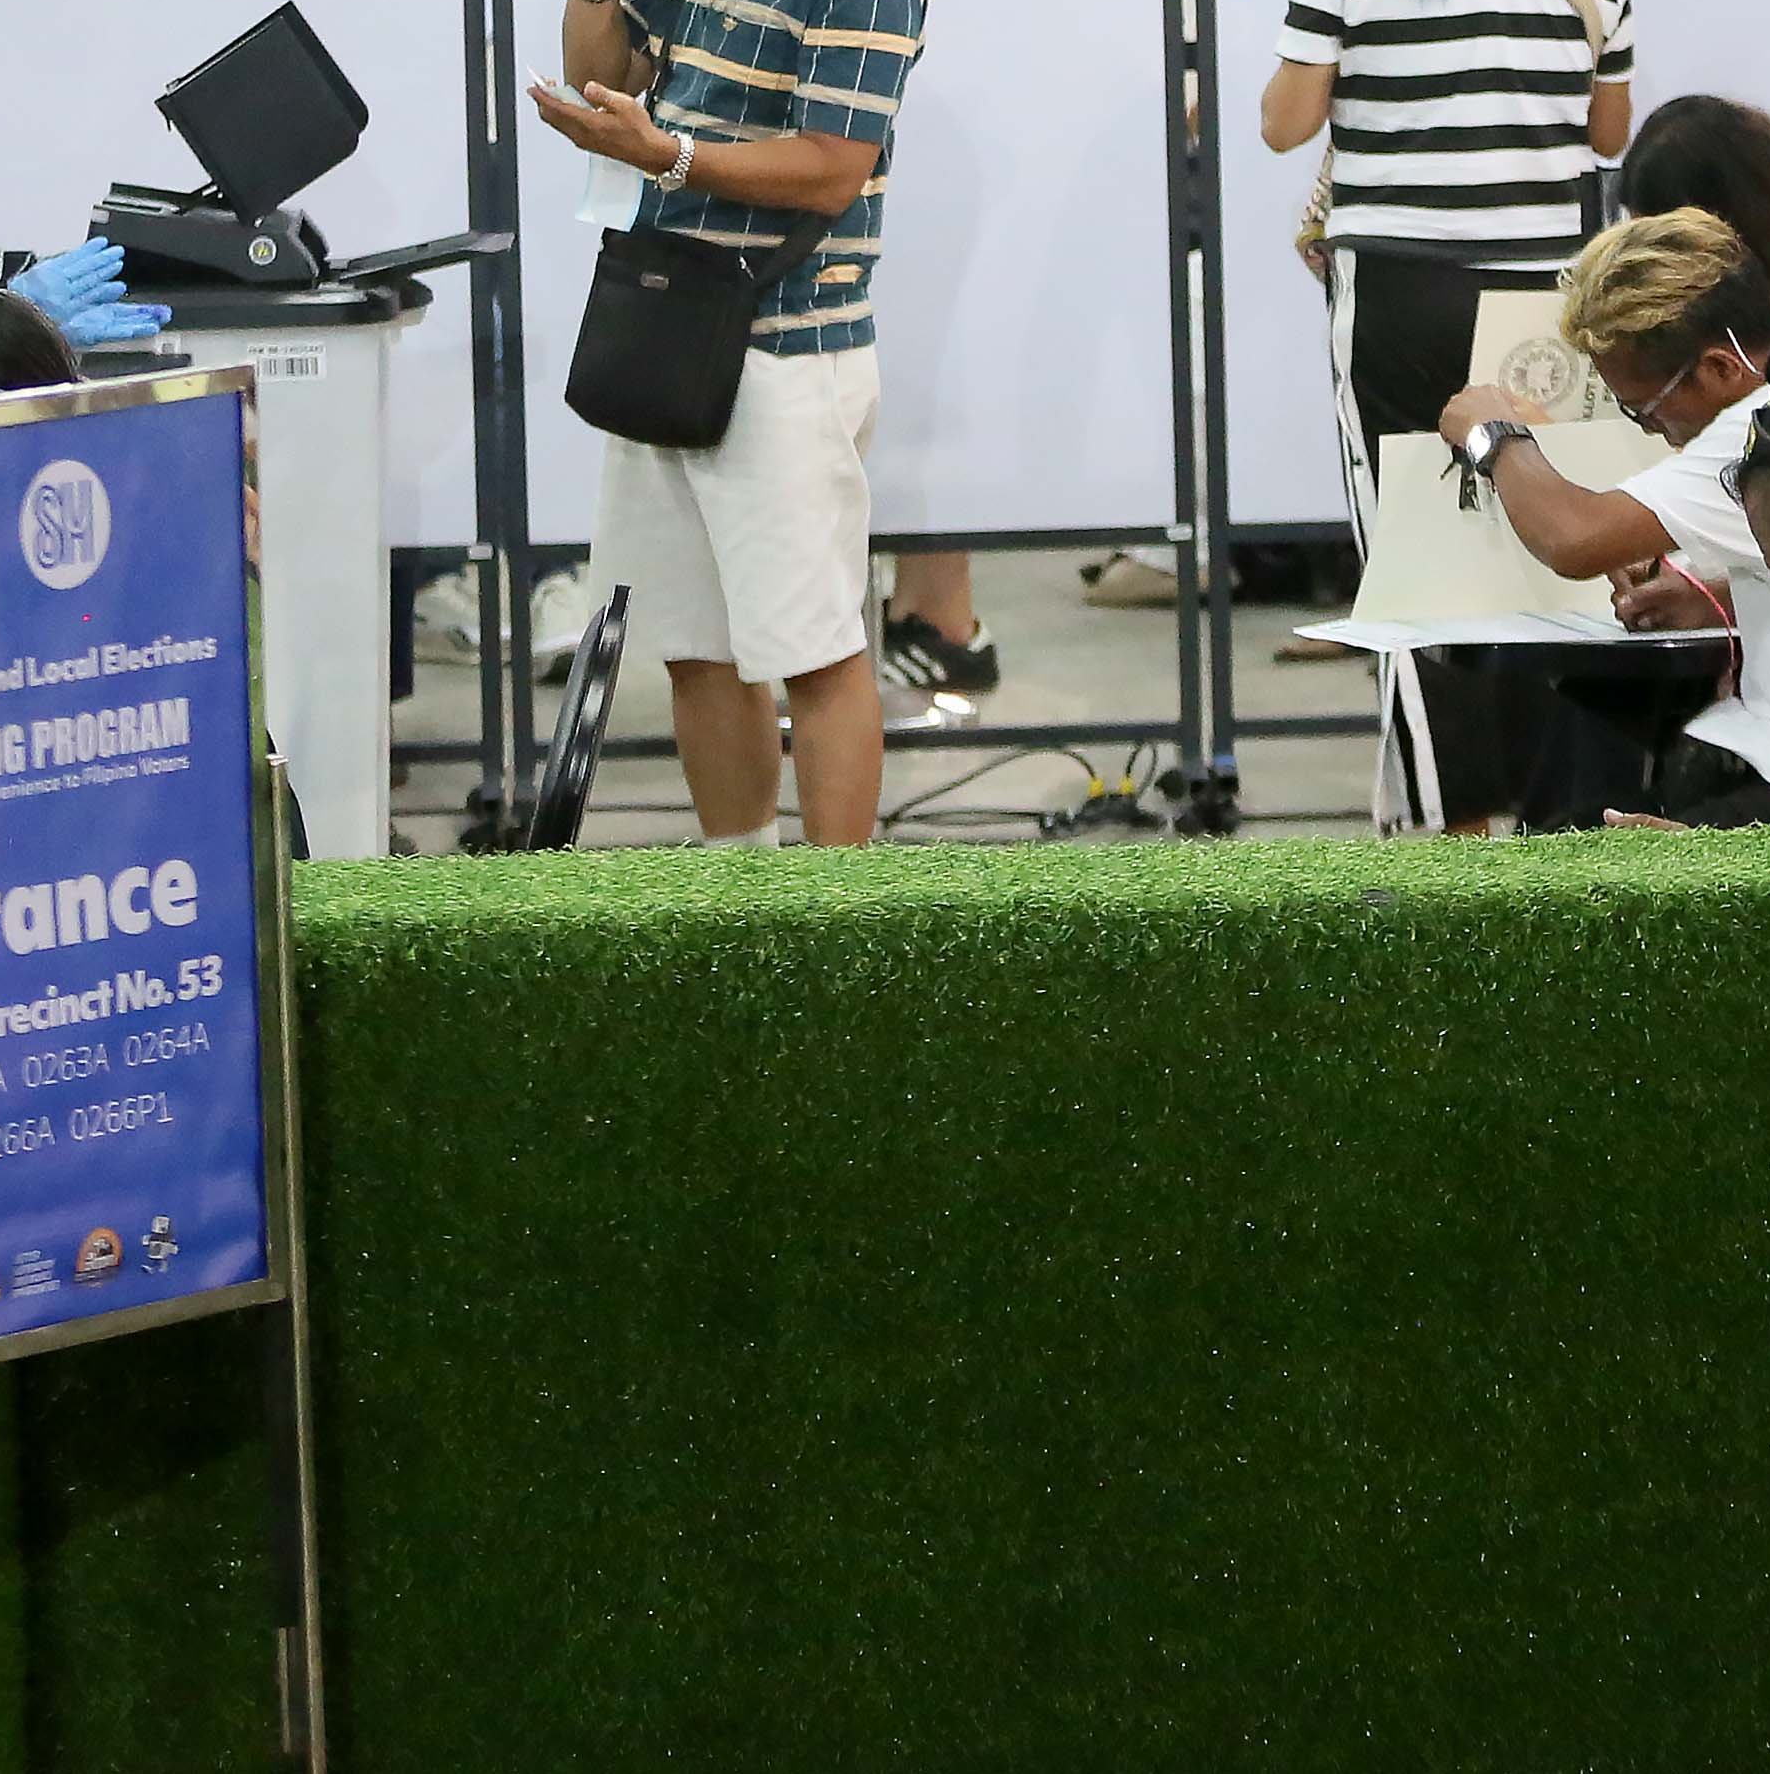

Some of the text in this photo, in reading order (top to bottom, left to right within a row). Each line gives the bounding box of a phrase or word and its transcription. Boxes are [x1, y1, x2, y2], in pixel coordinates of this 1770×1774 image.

[25, 646, 100, 686] Local
[100, 634, 218, 676] Elections
[30, 697, 191, 770] PROGRAM
[63, 772, 81, 789] to
[138, 755, 191, 777] Voters
[115, 968, 174, 1014] No.
[177, 954, 224, 1002] 53
[22, 1044, 111, 1089] 0263A
[124, 1023, 211, 1067] 0264A
[69, 1091, 175, 1143] 0266P1
